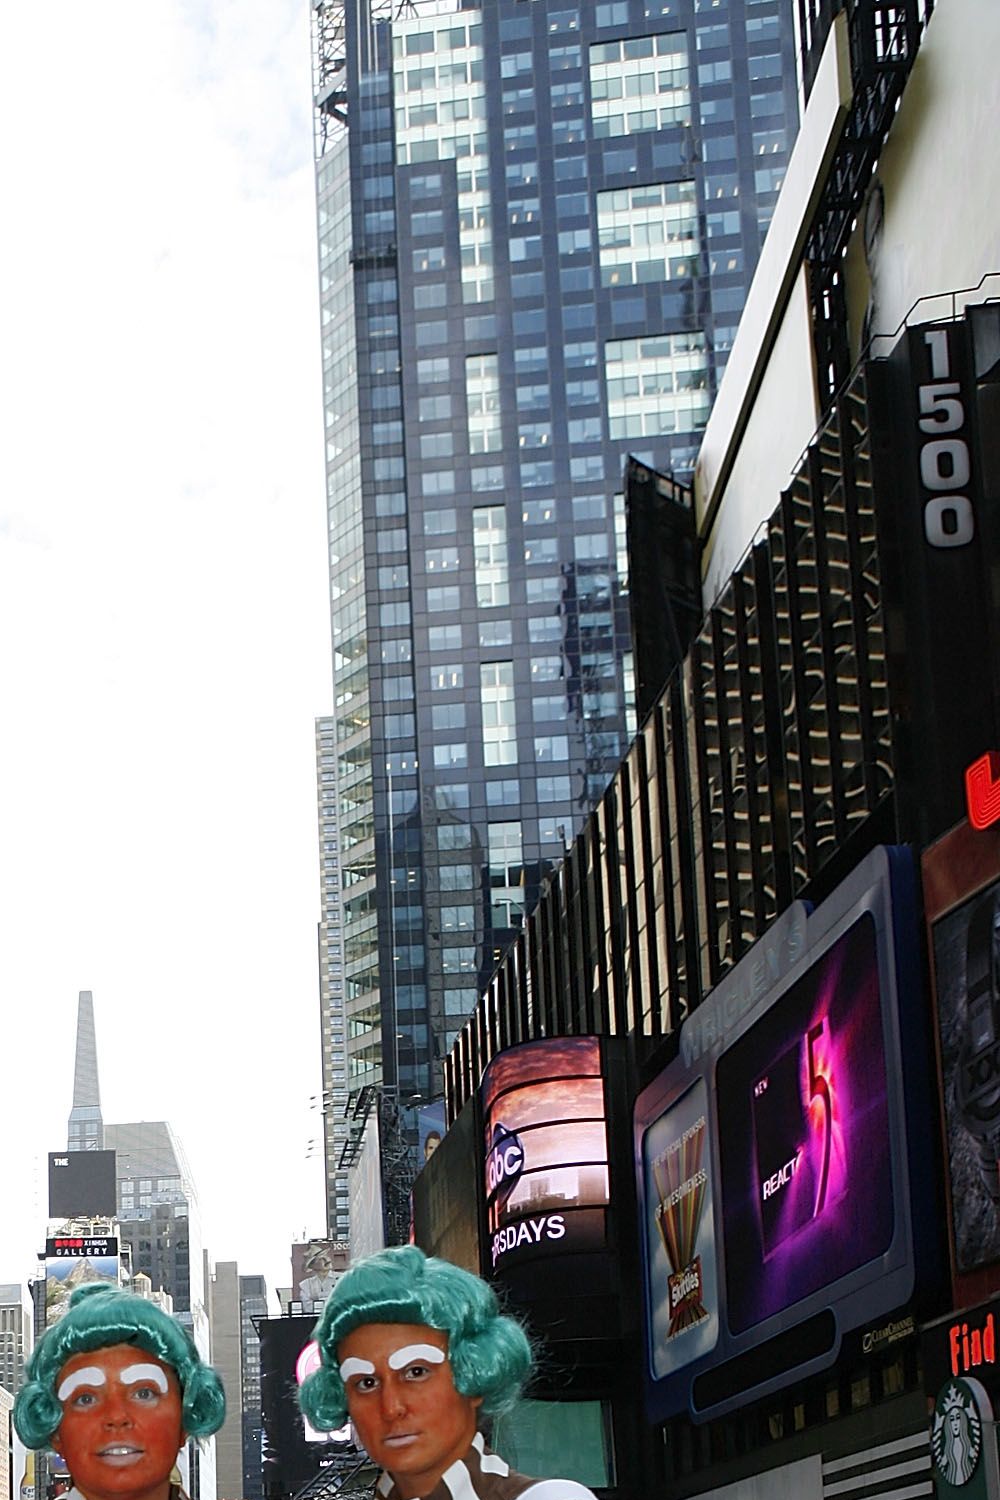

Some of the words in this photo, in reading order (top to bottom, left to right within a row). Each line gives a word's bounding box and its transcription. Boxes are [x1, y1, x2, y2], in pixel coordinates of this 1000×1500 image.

[918, 329, 974, 548] 1500
[754, 1077, 768, 1097] NEW
[54, 1158, 69, 1167] THE
[489, 1146, 522, 1190] abc
[56, 1248, 107, 1256] GALLERY
[671, 1272, 699, 1308] Skittles
[950, 1313, 994, 1376] Find
